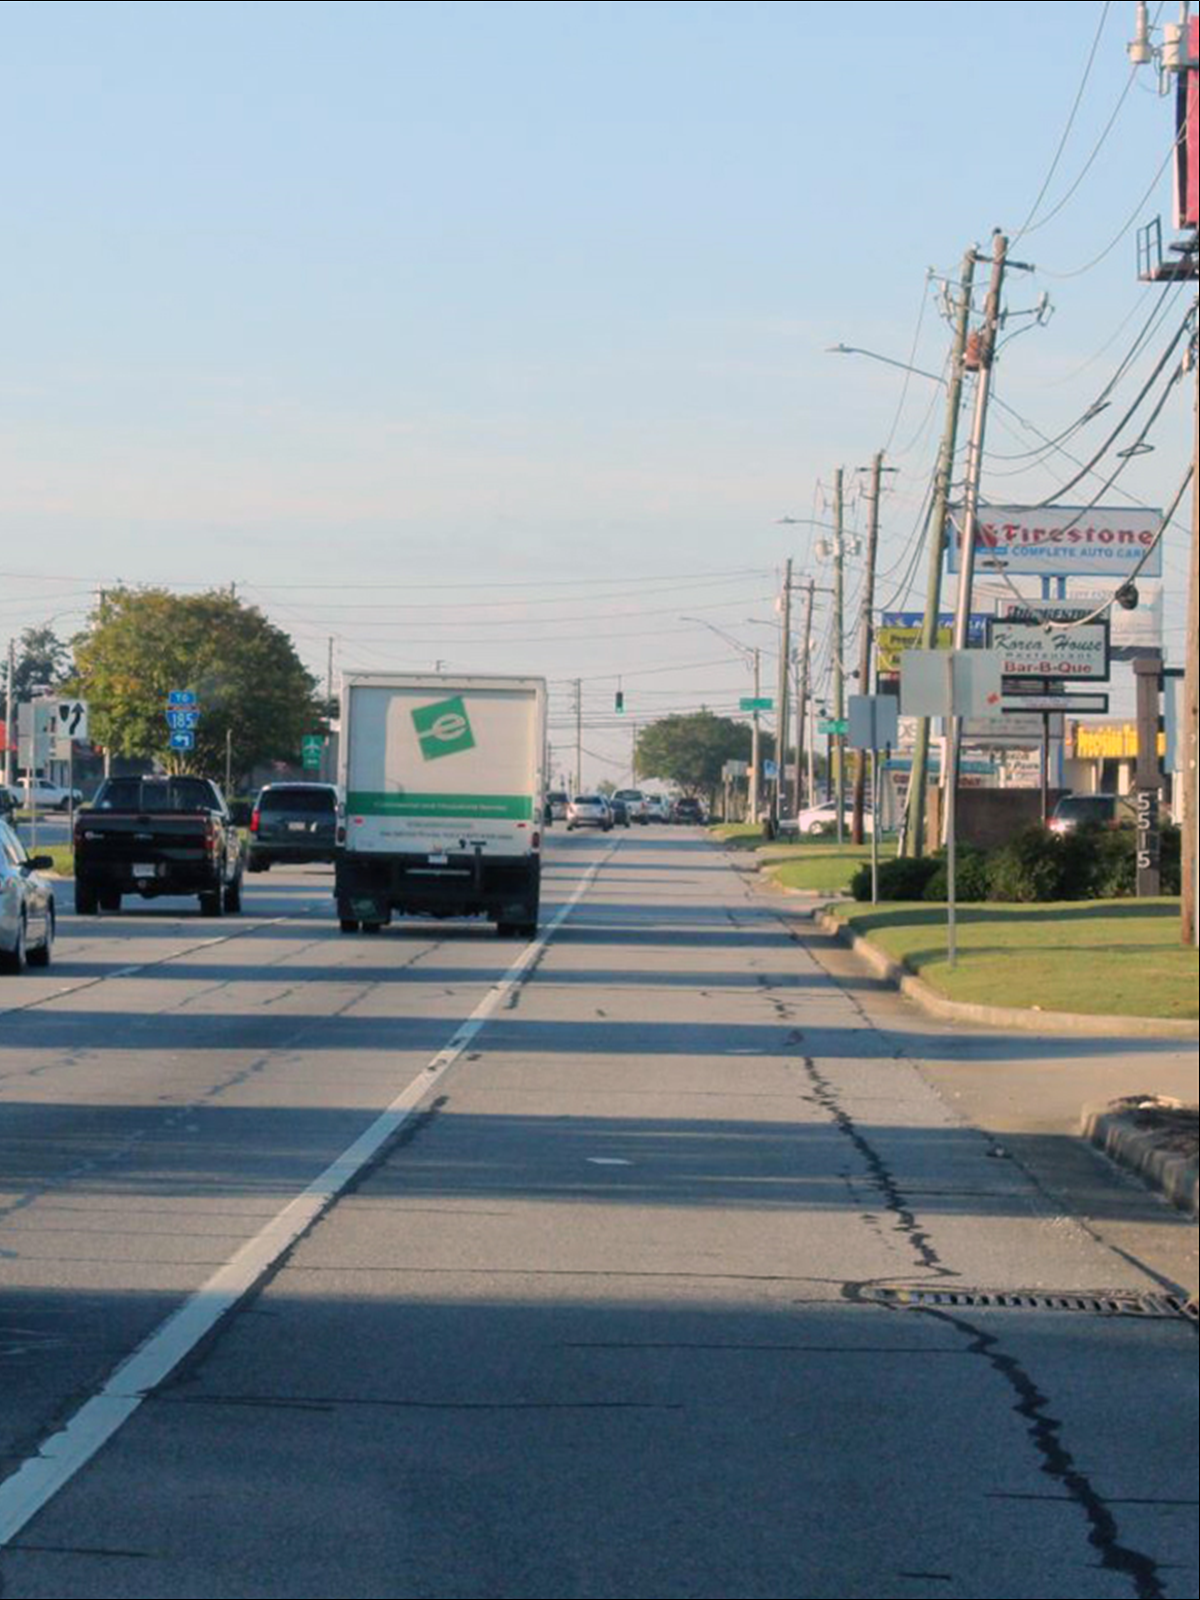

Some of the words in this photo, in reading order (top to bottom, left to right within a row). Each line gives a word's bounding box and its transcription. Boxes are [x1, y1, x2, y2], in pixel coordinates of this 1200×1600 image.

[1002, 524, 1154, 547] Firestone
[1011, 546, 1075, 558] COMPLETE
[1080, 546, 1113, 558] AUTO
[995, 633, 1043, 650] Korea
[1051, 633, 1103, 652] House
[1004, 661, 1092, 673] Bar-B-Que
[175, 693, 191, 702] TO
[172, 712, 195, 729] 185
[1137, 793, 1150, 869] 5515
